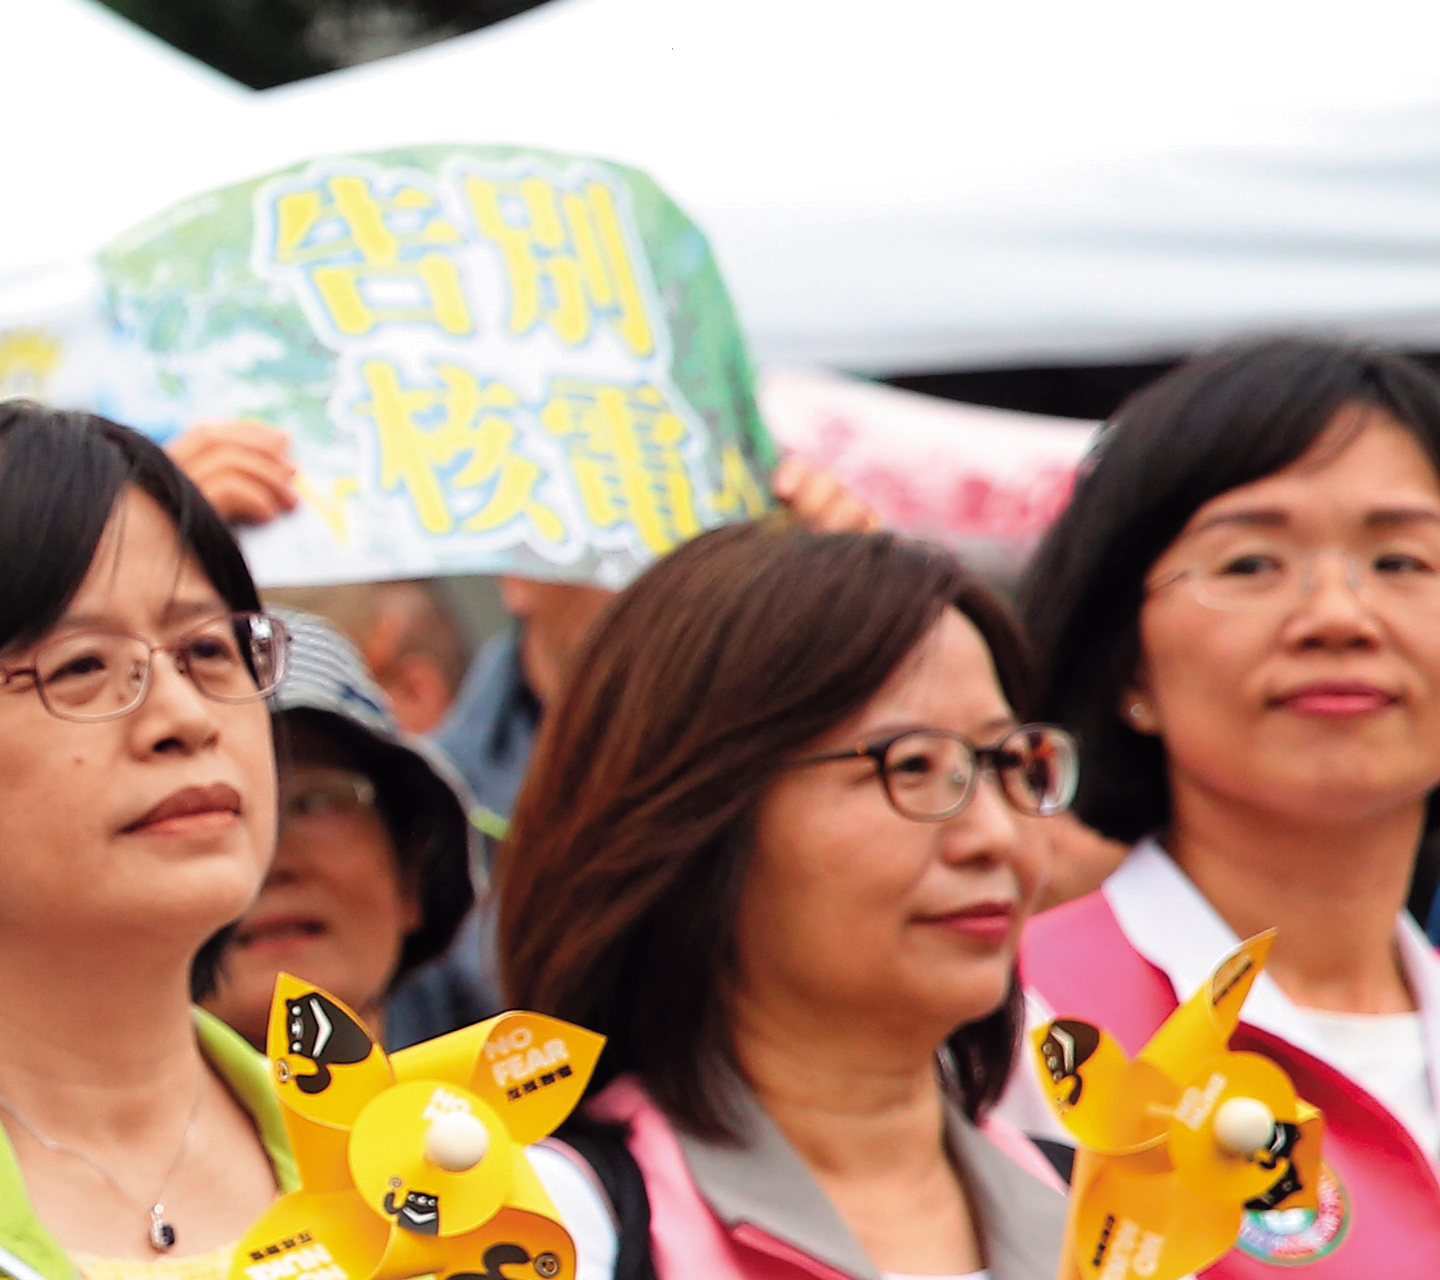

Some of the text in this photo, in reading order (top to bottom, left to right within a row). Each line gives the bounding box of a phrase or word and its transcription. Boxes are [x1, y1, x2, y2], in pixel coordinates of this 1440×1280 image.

[274, 174, 655, 358] 告別
[354, 360, 702, 556] 核電
[484, 1026, 533, 1061] NO
[491, 1038, 570, 1088] FEAR
